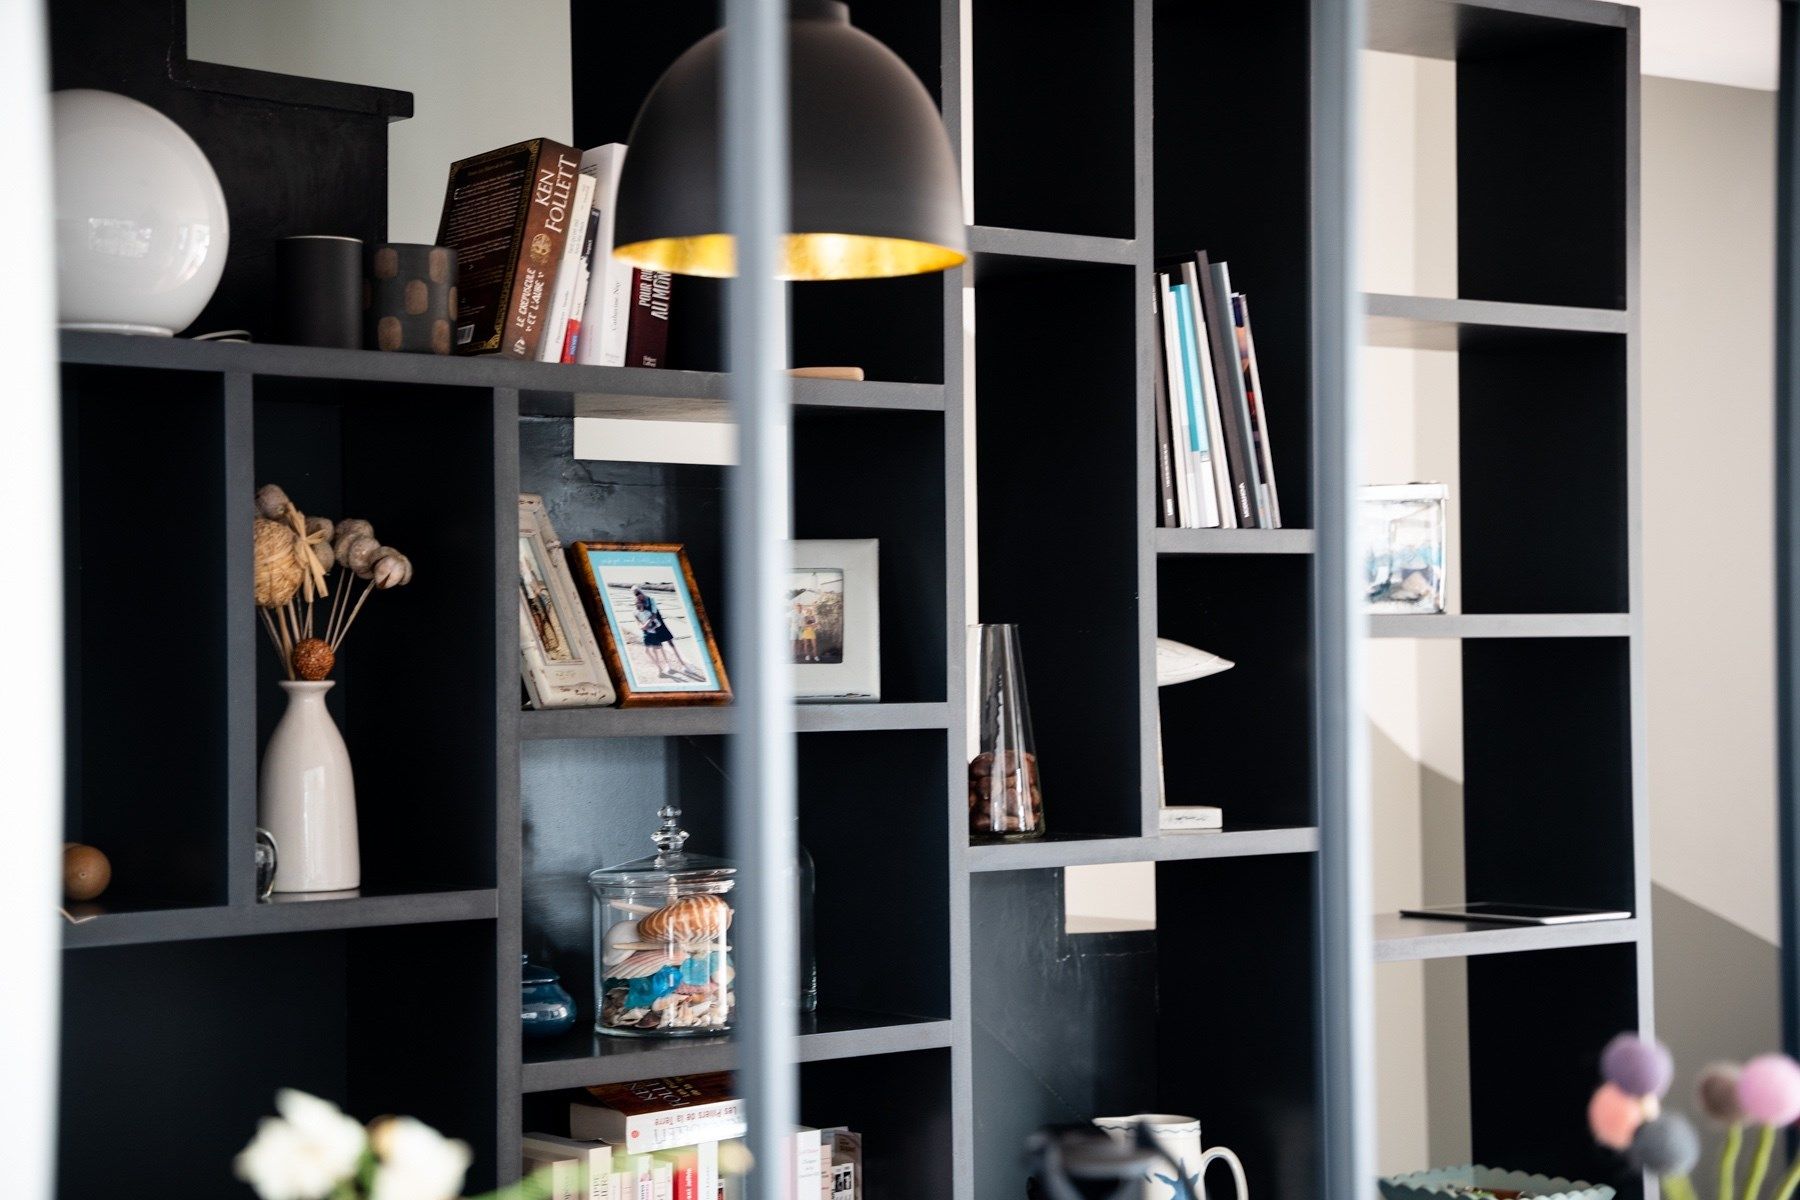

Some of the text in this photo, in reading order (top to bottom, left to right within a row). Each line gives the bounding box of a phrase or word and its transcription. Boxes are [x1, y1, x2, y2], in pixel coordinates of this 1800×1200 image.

[534, 168, 556, 207] KEN
[544, 153, 578, 234] FOLLETT
[638, 282, 653, 307] POUR
[650, 271, 673, 321] AU MON
